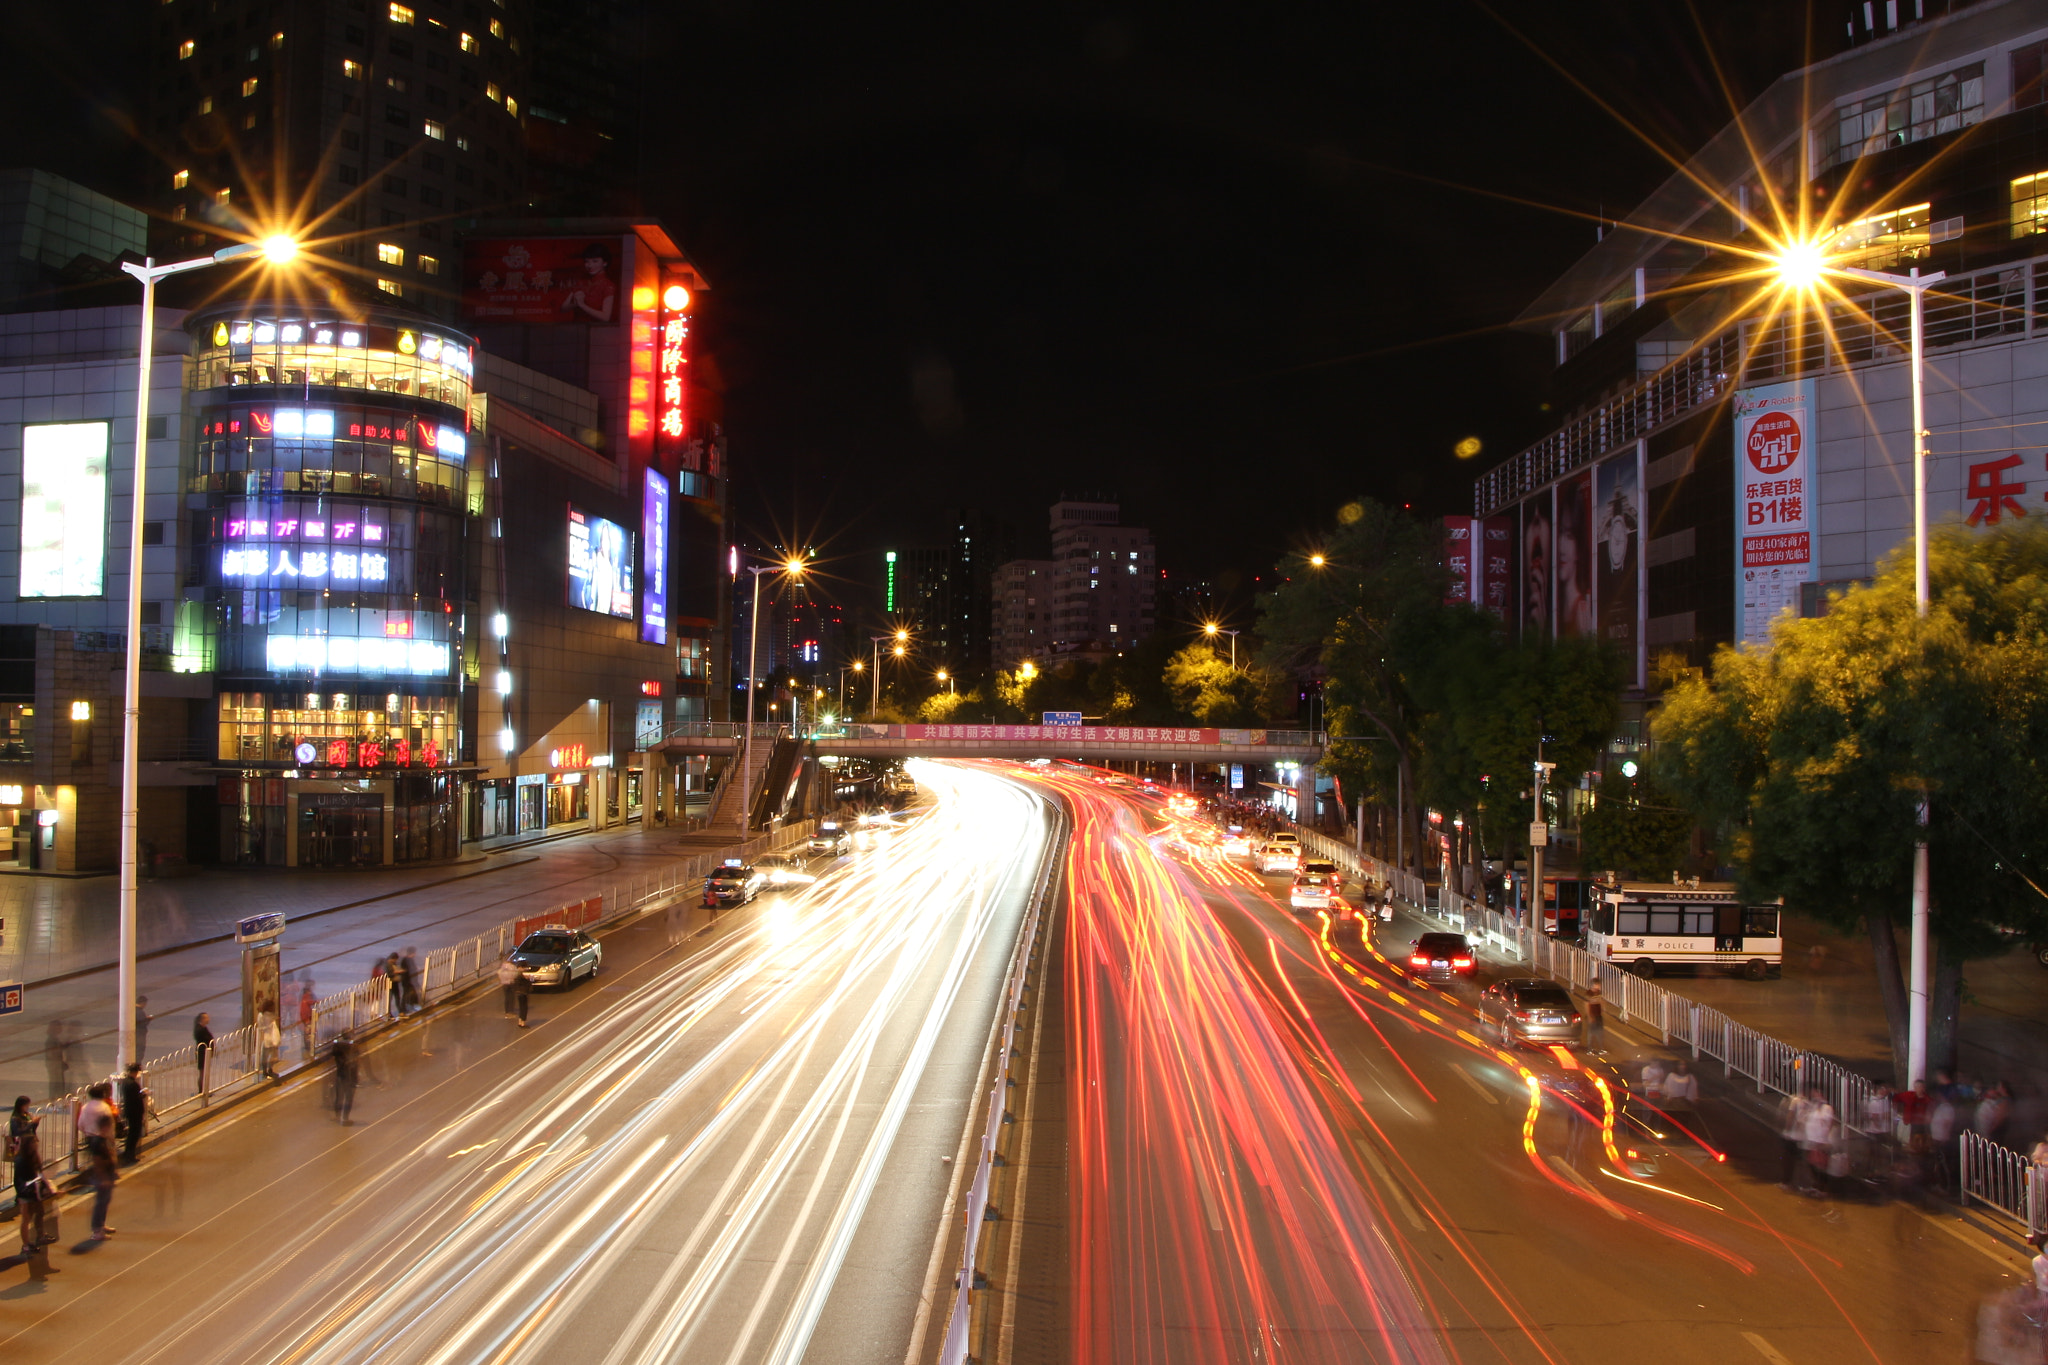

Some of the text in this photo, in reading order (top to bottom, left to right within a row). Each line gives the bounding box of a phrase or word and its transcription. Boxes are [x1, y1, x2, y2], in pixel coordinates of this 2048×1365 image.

[1770, 394, 1807, 407] Robbinz
[350, 423, 407, 441] 自助火锅
[1756, 419, 1791, 432] 潮流生活馆
[1751, 434, 1765, 449] IN
[1746, 477, 1803, 500] 乐宾百货
[1965, 453, 2048, 528] 乐
[1747, 497, 1803, 526] B1楼
[1745, 534, 1808, 551] 超过40家商户
[1745, 549, 1809, 564] 期待您的光临!
[924, 725, 1201, 742] 共建美丽天津 共享美好生活 文明和平欢迎您
[328, 739, 438, 768] 國際商場
[1621, 938, 1695, 950] 警察 POLICE
